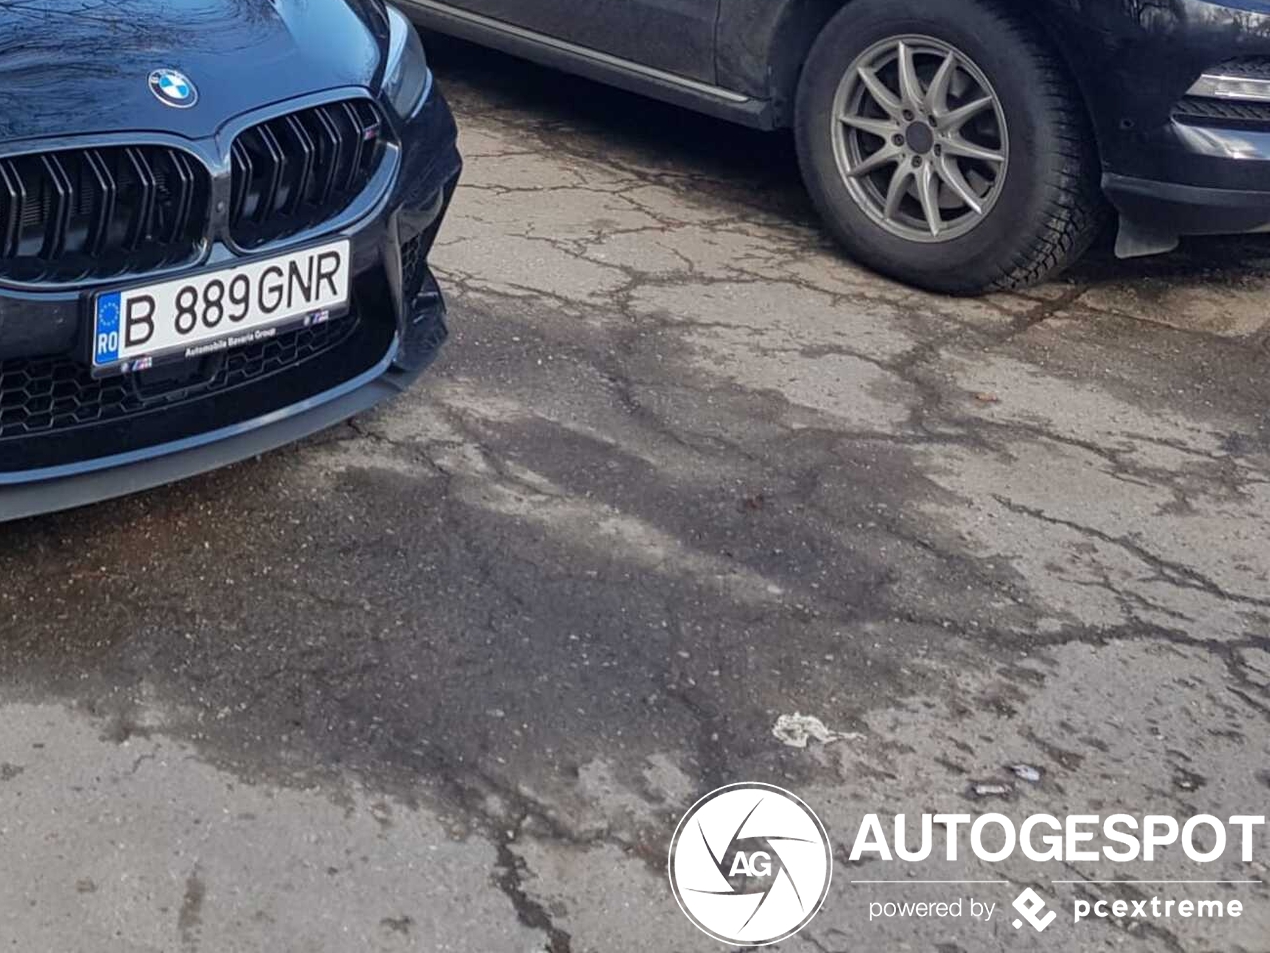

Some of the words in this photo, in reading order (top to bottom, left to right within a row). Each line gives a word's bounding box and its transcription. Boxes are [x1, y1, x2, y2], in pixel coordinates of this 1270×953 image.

[124, 294, 156, 348] B
[98, 331, 118, 355] RO
[185, 340, 228, 358] Automobile
[228, 333, 254, 346] Bavaria
[255, 327, 277, 340] Group
